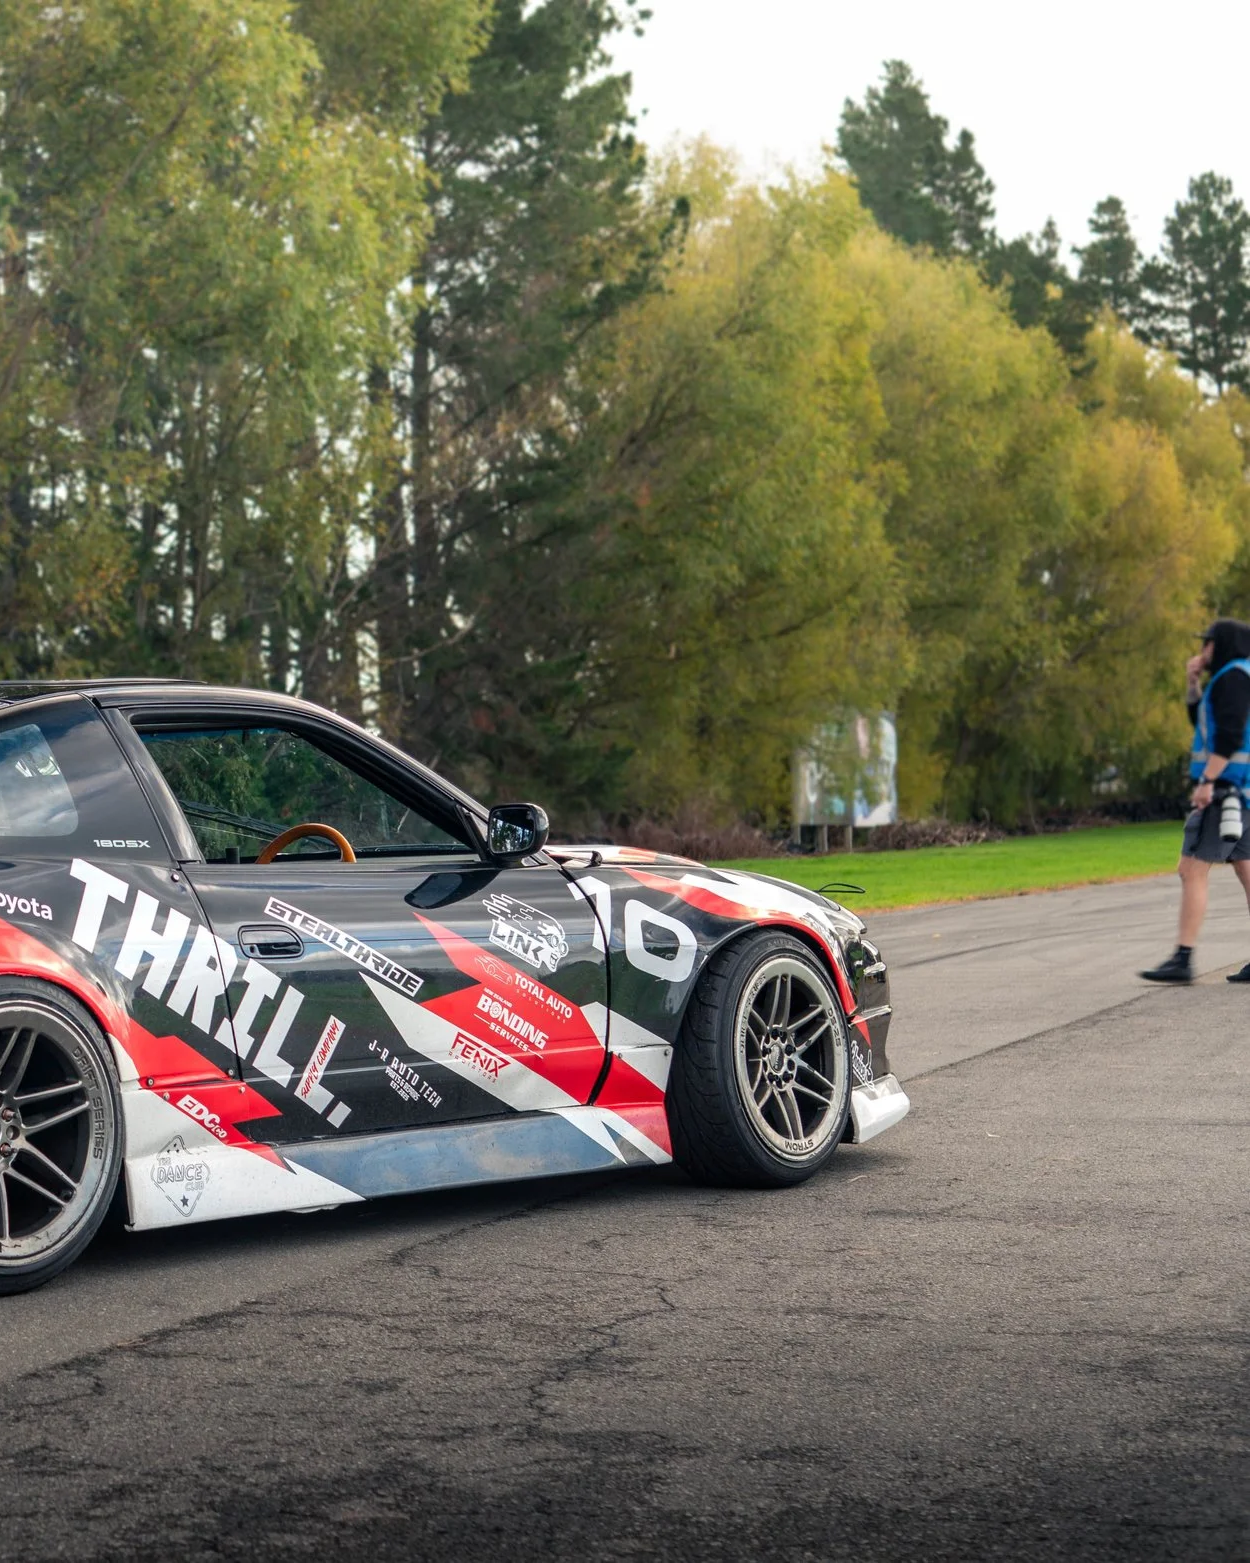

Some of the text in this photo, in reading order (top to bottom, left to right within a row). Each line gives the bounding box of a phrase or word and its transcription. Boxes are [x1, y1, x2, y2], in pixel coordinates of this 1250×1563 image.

[93, 839, 151, 848] 180SX
[267, 898, 421, 995] STEALTHRIDE
[491, 920, 545, 962] LINK
[514, 972, 573, 1019] TOTAL AUTO
[476, 993, 549, 1050] BONDING
[489, 1021, 530, 1053] SERVICES
[301, 1019, 340, 1099] SUPPLY COMPANY
[368, 1039, 443, 1108] J-R AUTO TECH
[451, 1031, 511, 1078] FENIX
[71, 1046, 100, 1092] DRIFT
[91, 1096, 106, 1161] SERIES
[784, 1138, 815, 1152] STROM
[156, 1163, 203, 1184] DANCE
